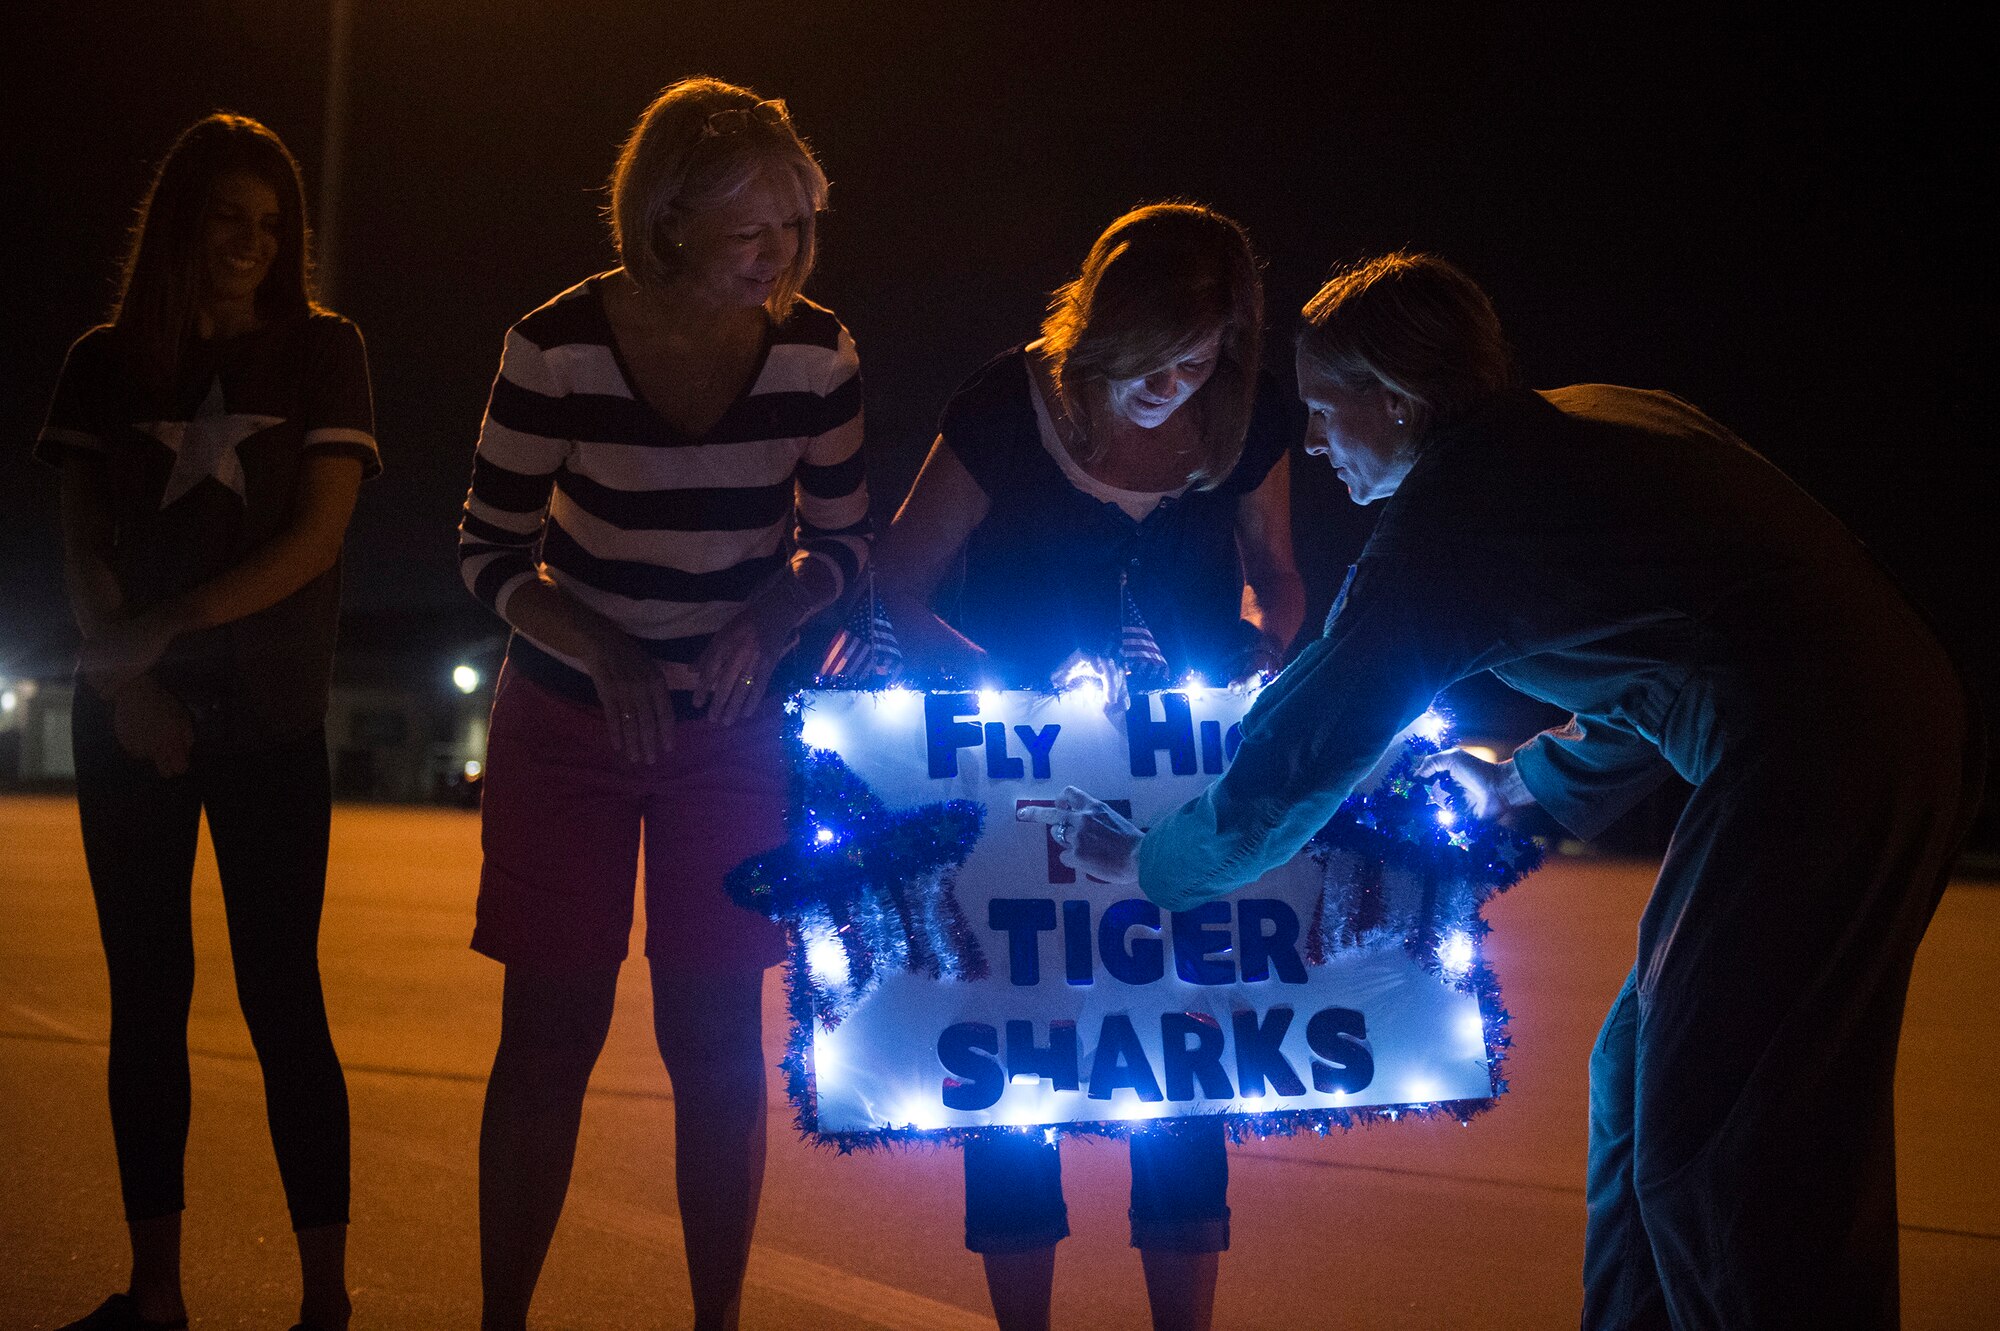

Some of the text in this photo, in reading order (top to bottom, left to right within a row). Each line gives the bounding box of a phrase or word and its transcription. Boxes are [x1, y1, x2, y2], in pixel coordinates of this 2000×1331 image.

[924, 693, 1061, 779] FLY
[988, 898, 1308, 986] TIGER
[937, 1008, 1375, 1111] SHARKS
